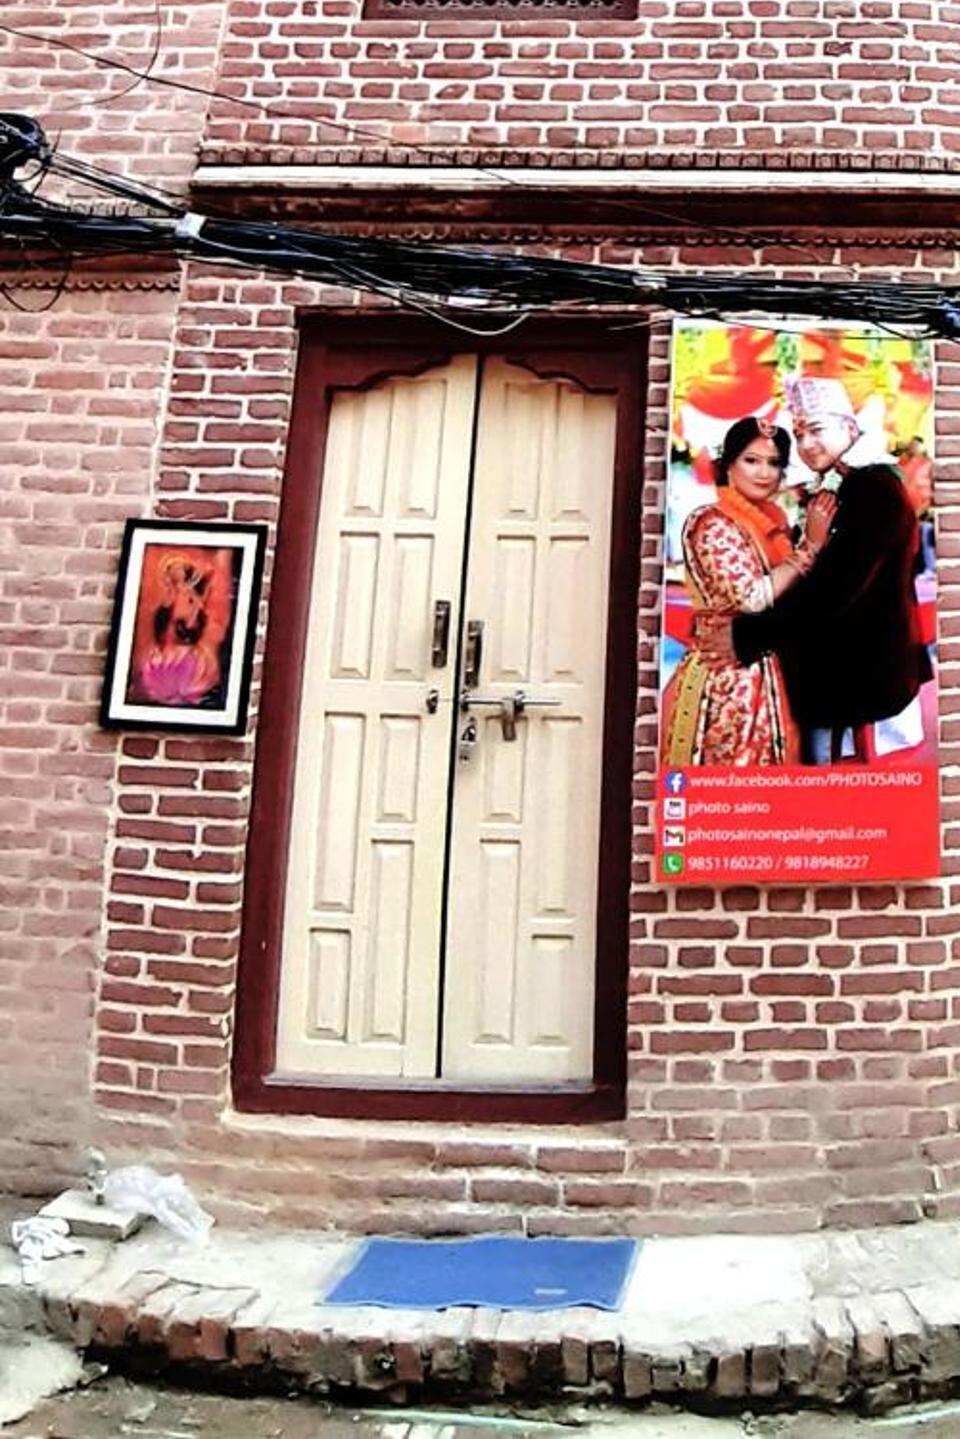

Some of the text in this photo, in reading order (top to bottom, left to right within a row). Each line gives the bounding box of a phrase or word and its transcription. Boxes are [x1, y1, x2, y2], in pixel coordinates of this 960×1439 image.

[690, 772, 922, 789] www.facebook.com/PHOTOSAINO
[688, 800, 770, 817] photo saino
